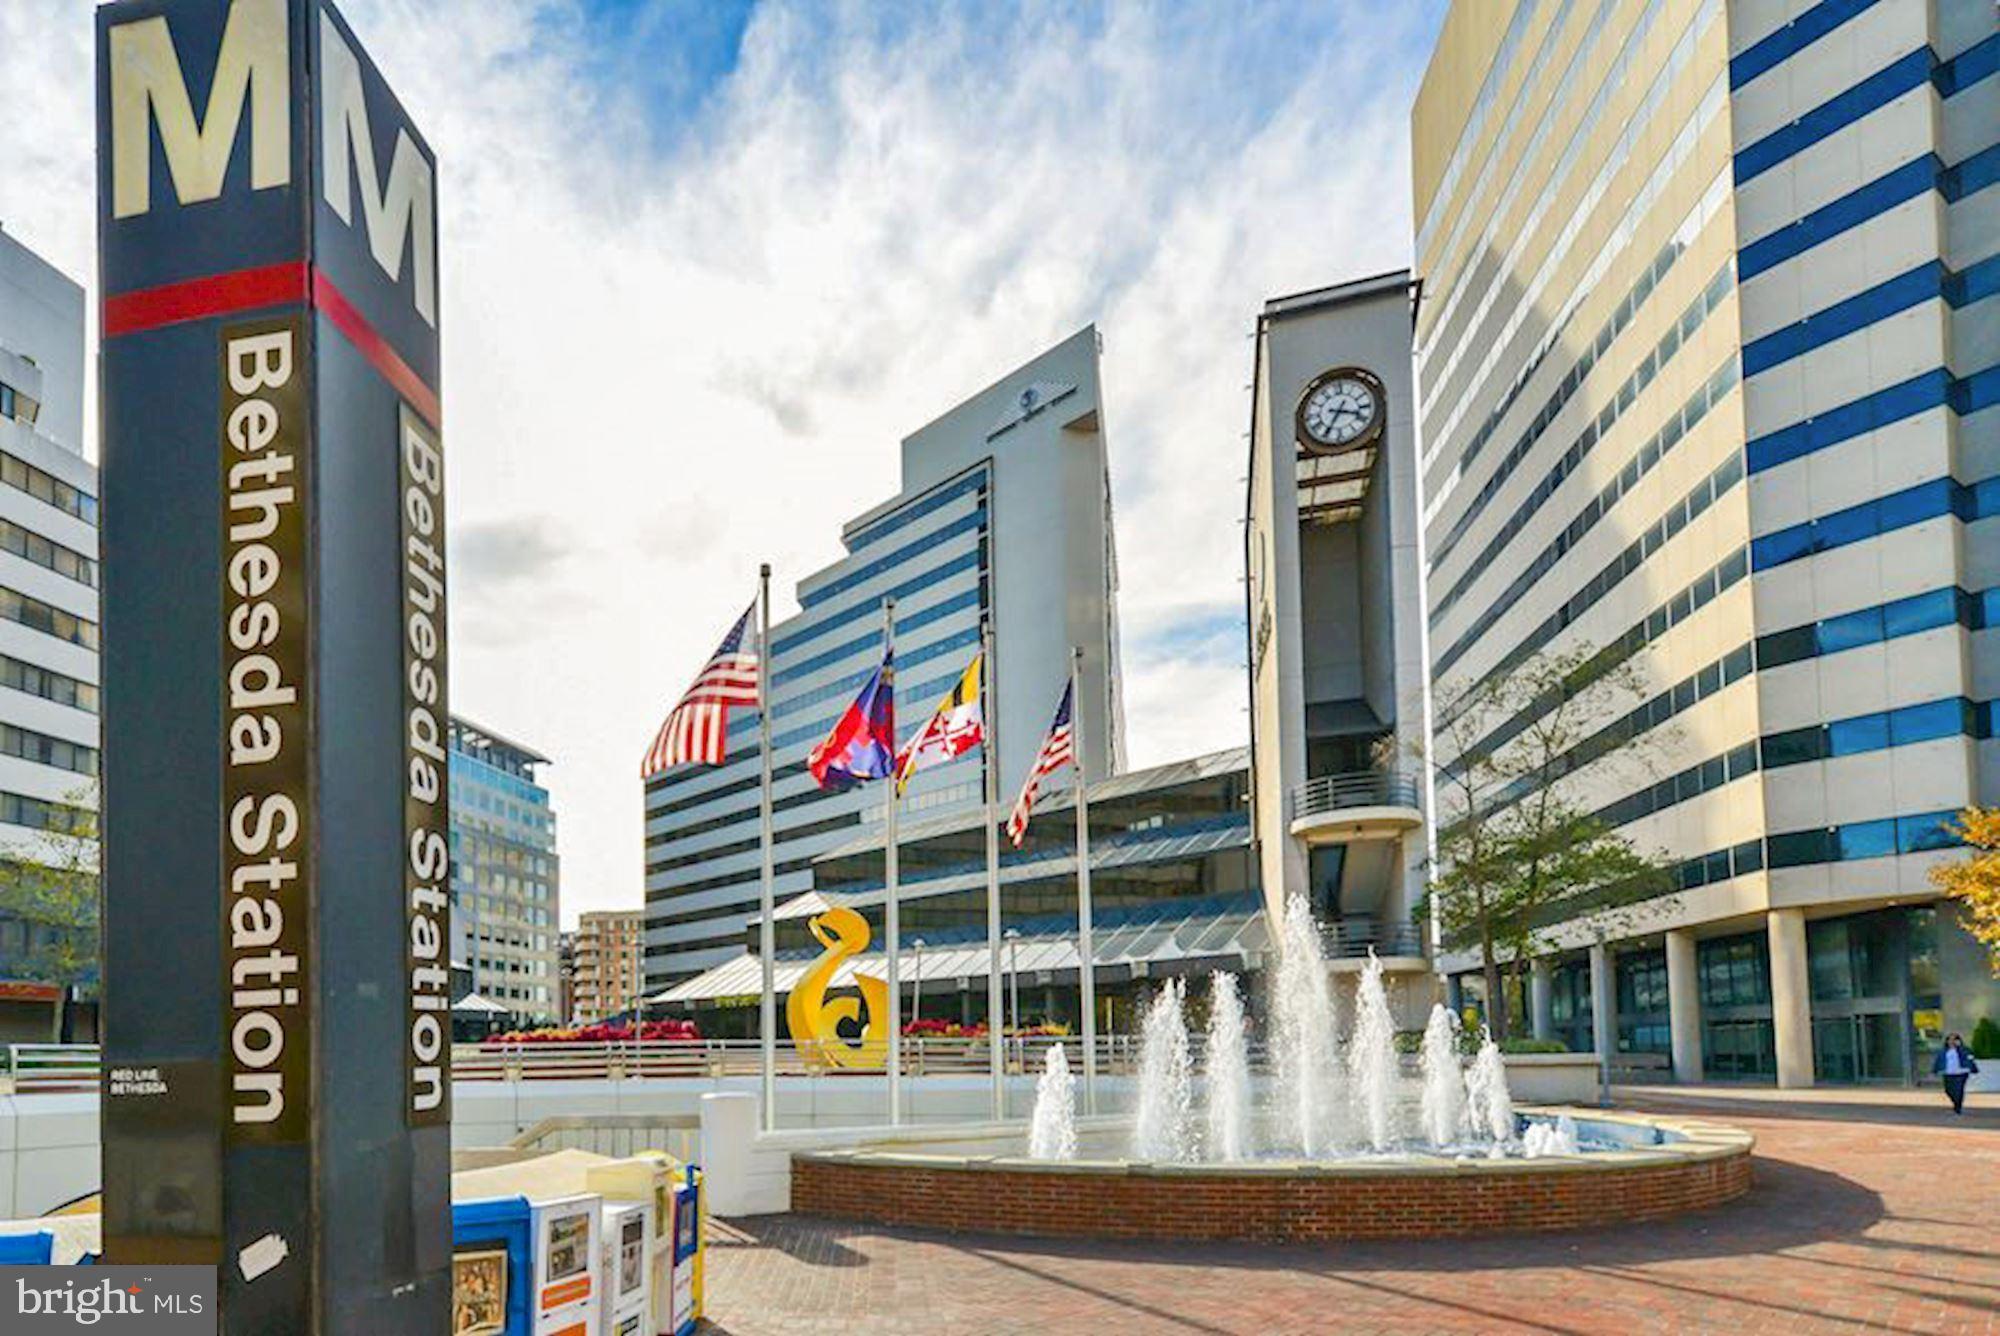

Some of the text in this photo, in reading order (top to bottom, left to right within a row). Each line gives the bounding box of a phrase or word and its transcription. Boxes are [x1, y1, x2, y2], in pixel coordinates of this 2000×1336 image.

[109, 0, 291, 219] M
[319, 8, 435, 329] M
[228, 330, 299, 1123] Bethesda Station
[404, 424, 449, 1112] Bethesda Station
[110, 1069, 134, 1081] RED
[110, 1081, 168, 1095] BETHESDA
